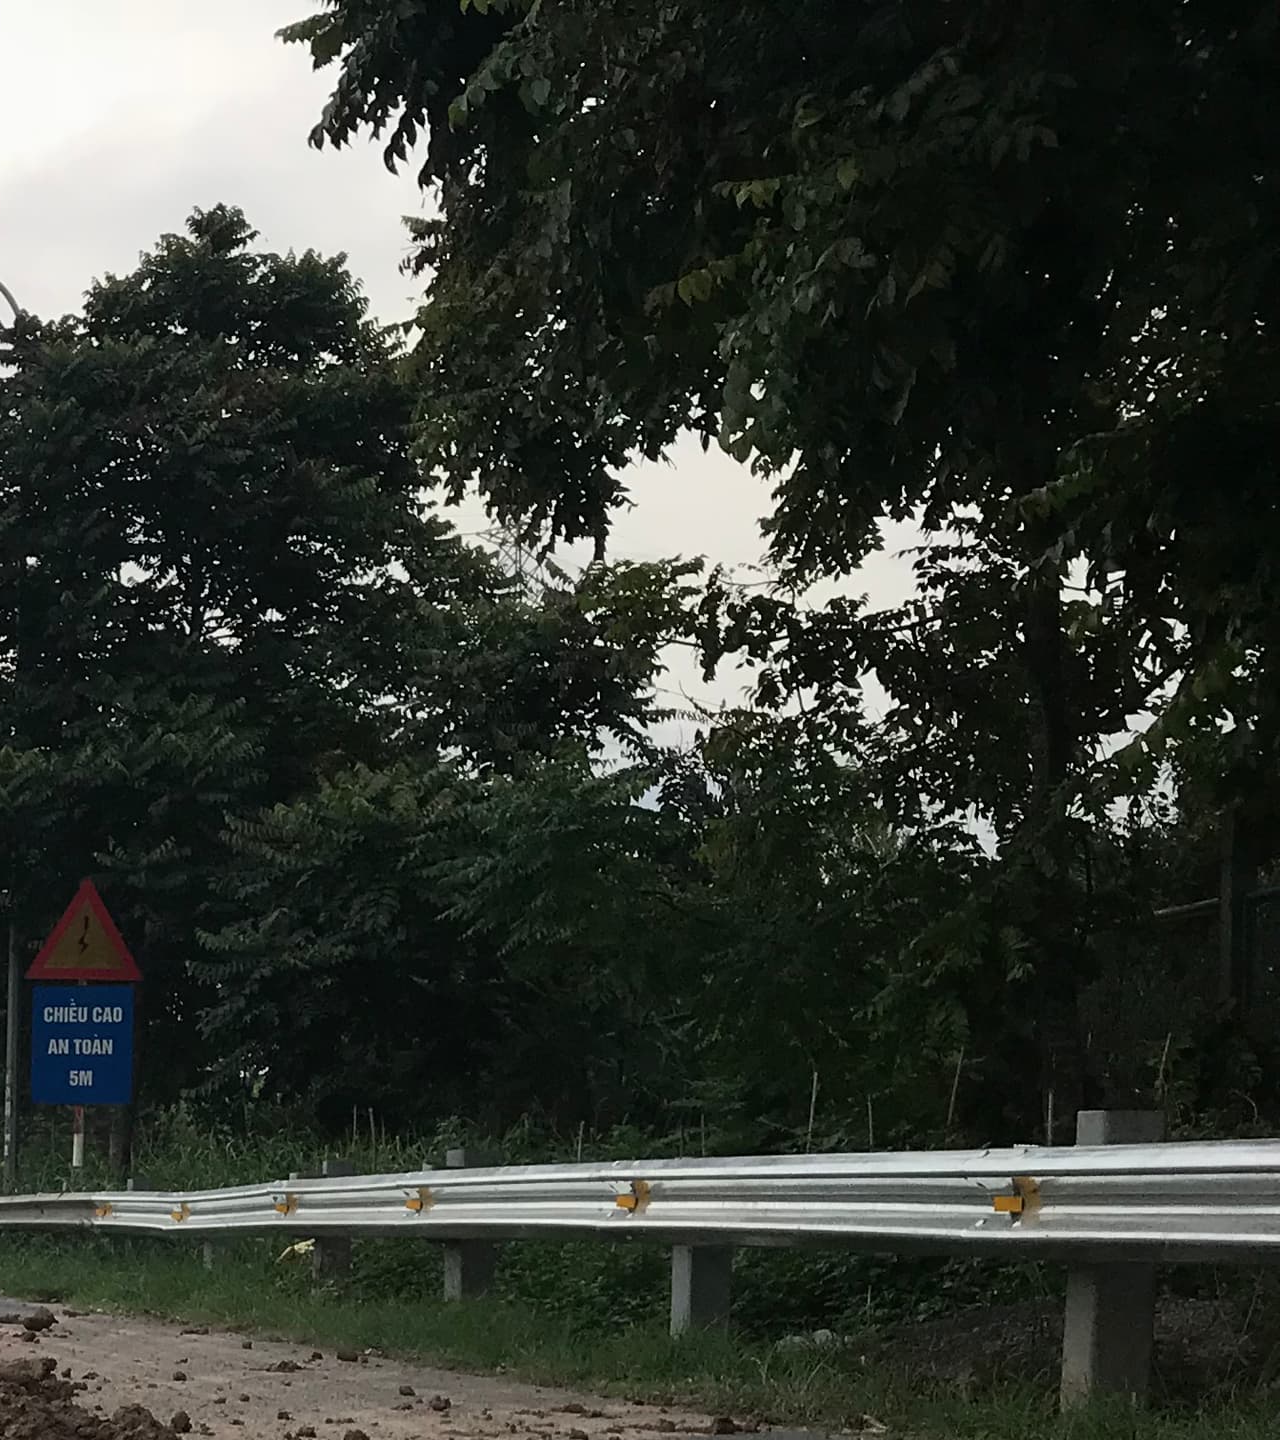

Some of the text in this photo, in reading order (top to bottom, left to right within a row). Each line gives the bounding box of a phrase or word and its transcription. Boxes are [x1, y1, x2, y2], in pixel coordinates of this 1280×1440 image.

[43, 998, 123, 1023] CHIỀU CAO
[47, 1033, 113, 1055] AN TOÀN
[69, 1070, 93, 1087] 5M
